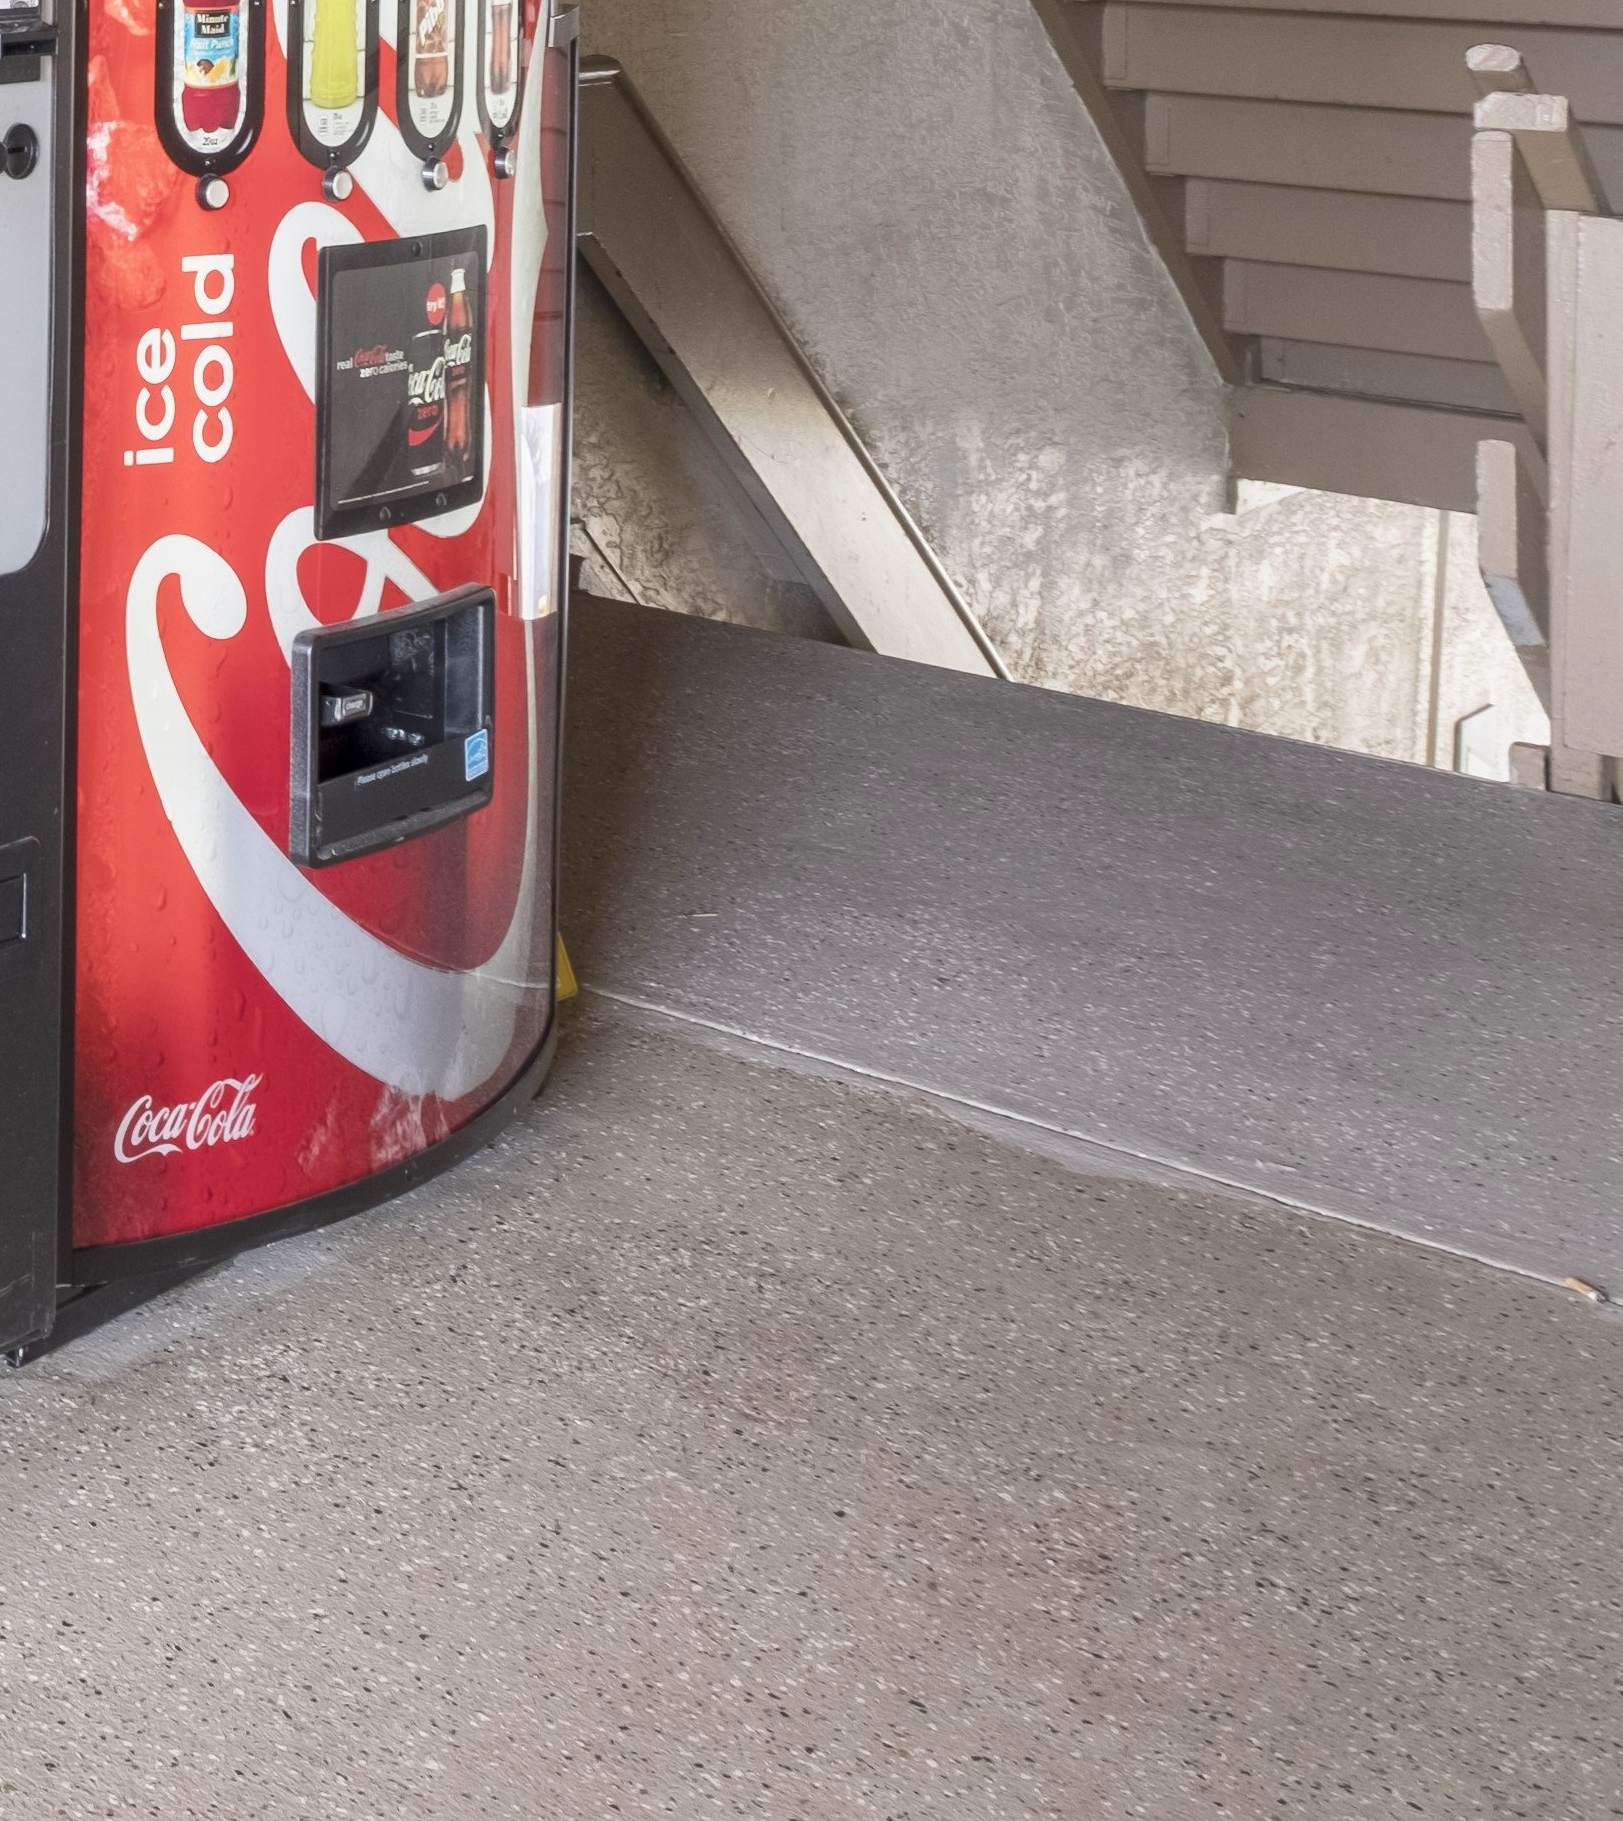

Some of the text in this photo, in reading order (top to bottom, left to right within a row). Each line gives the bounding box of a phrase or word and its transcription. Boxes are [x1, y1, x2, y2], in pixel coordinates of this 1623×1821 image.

[196, 13, 229, 24] Minute
[200, 24, 225, 35] Maid
[191, 38, 233, 50] Fruit Punch
[426, 300, 438, 313] try
[181, 253, 235, 464] cold
[337, 357, 354, 371] real
[385, 350, 404, 362] taste
[360, 361, 408, 378] zero calories
[124, 325, 176, 468] ice
[417, 405, 438, 420] zero
[357, 772, 376, 786] Please
[114, 1073, 264, 1163] Coca-Cola
